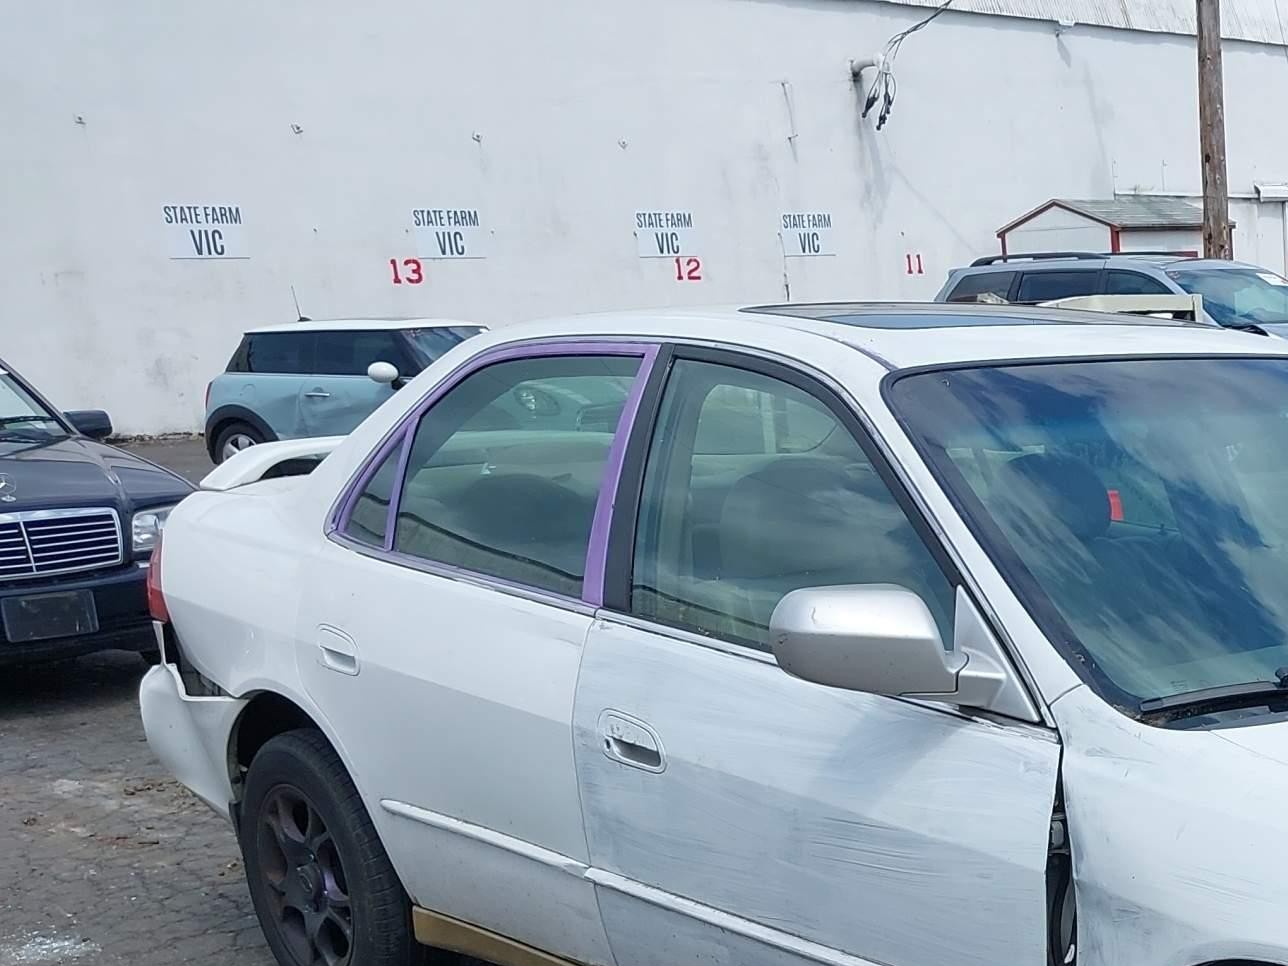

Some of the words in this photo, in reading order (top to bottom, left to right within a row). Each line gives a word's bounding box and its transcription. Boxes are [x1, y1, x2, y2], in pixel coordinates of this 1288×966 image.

[163, 206, 200, 224] STATE
[203, 206, 242, 225] FARM
[413, 209, 445, 226] STATE
[446, 210, 479, 227] FARM
[636, 212, 664, 228] STATE
[665, 212, 693, 228] FARM
[782, 214, 806, 229] STATE
[807, 214, 832, 229] FARM
[190, 229, 225, 255] VIC
[435, 231, 465, 255] VIC
[655, 232, 680, 254] VIC
[798, 232, 820, 253] VIC
[390, 258, 423, 284] 13
[675, 257, 702, 280] 12
[906, 254, 924, 274] 11
